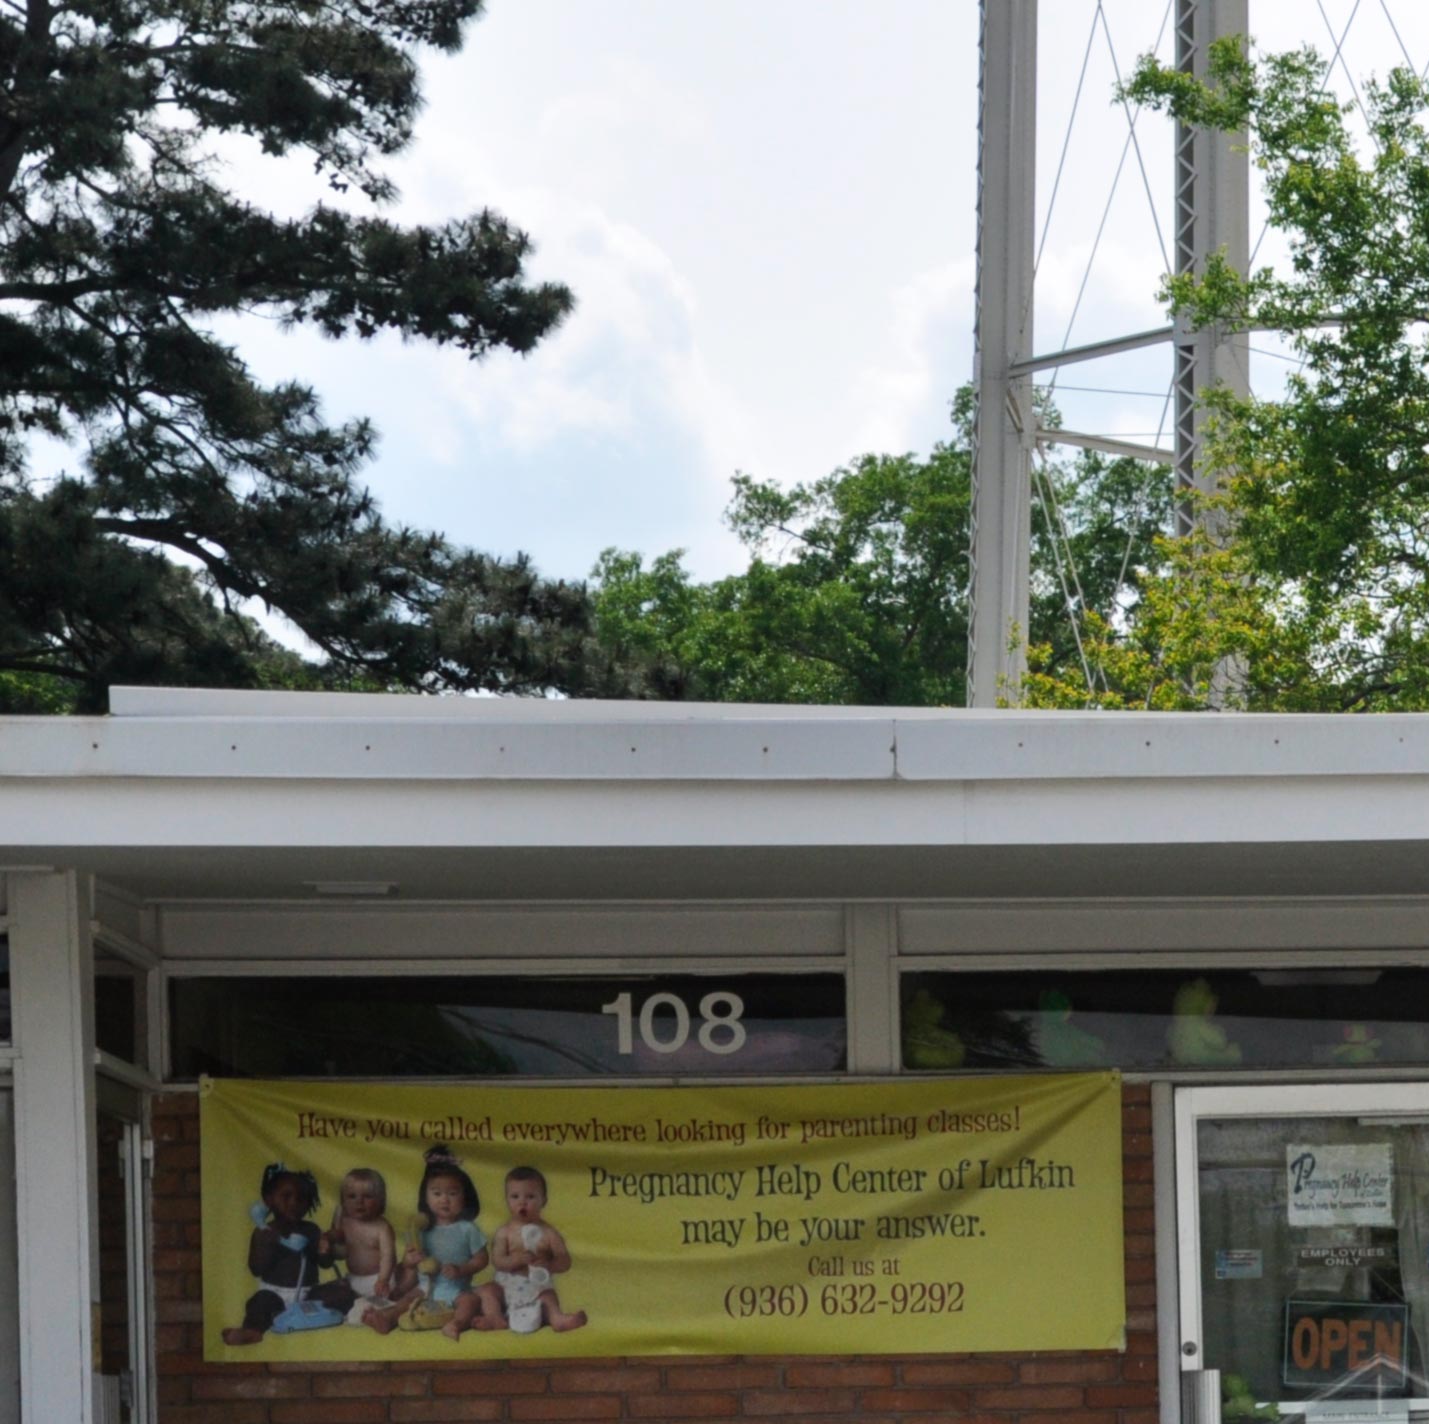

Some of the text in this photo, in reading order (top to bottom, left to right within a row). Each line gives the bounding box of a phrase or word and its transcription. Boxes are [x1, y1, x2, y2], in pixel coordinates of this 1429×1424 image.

[602, 991, 747, 1054] 108
[298, 1105, 1021, 1146] Have you called everywhere looking for parenting classes!
[589, 1158, 1076, 1203] Pregnancy Help Center of Lufkin
[680, 1211, 987, 1248] may be your answer.
[807, 1256, 900, 1277] Call us at
[1300, 1247, 1385, 1258] EMPLOYEES
[1324, 1257, 1361, 1267] ONLY
[724, 1281, 966, 1319] (936) 632-9292
[1291, 1316, 1402, 1371] OPEN
